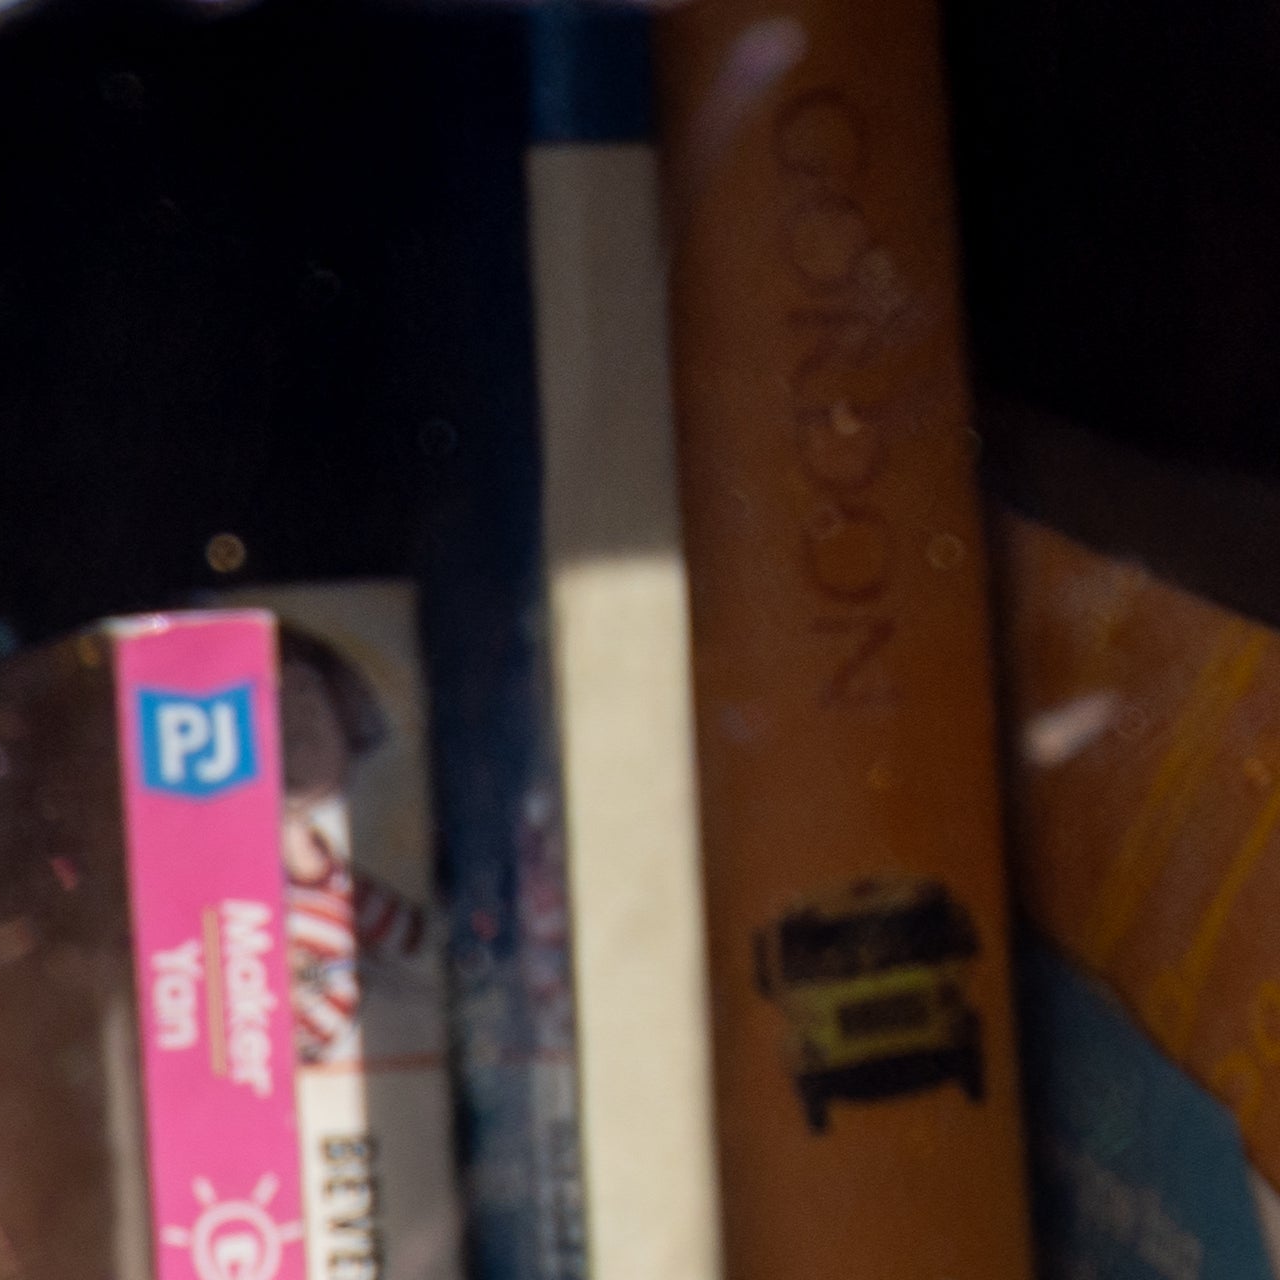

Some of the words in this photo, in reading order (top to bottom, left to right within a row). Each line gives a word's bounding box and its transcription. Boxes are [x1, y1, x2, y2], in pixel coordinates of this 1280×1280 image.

[155, 703, 238, 785] PJ
[148, 938, 200, 1051] Yan
[220, 898, 271, 1096] Maker
